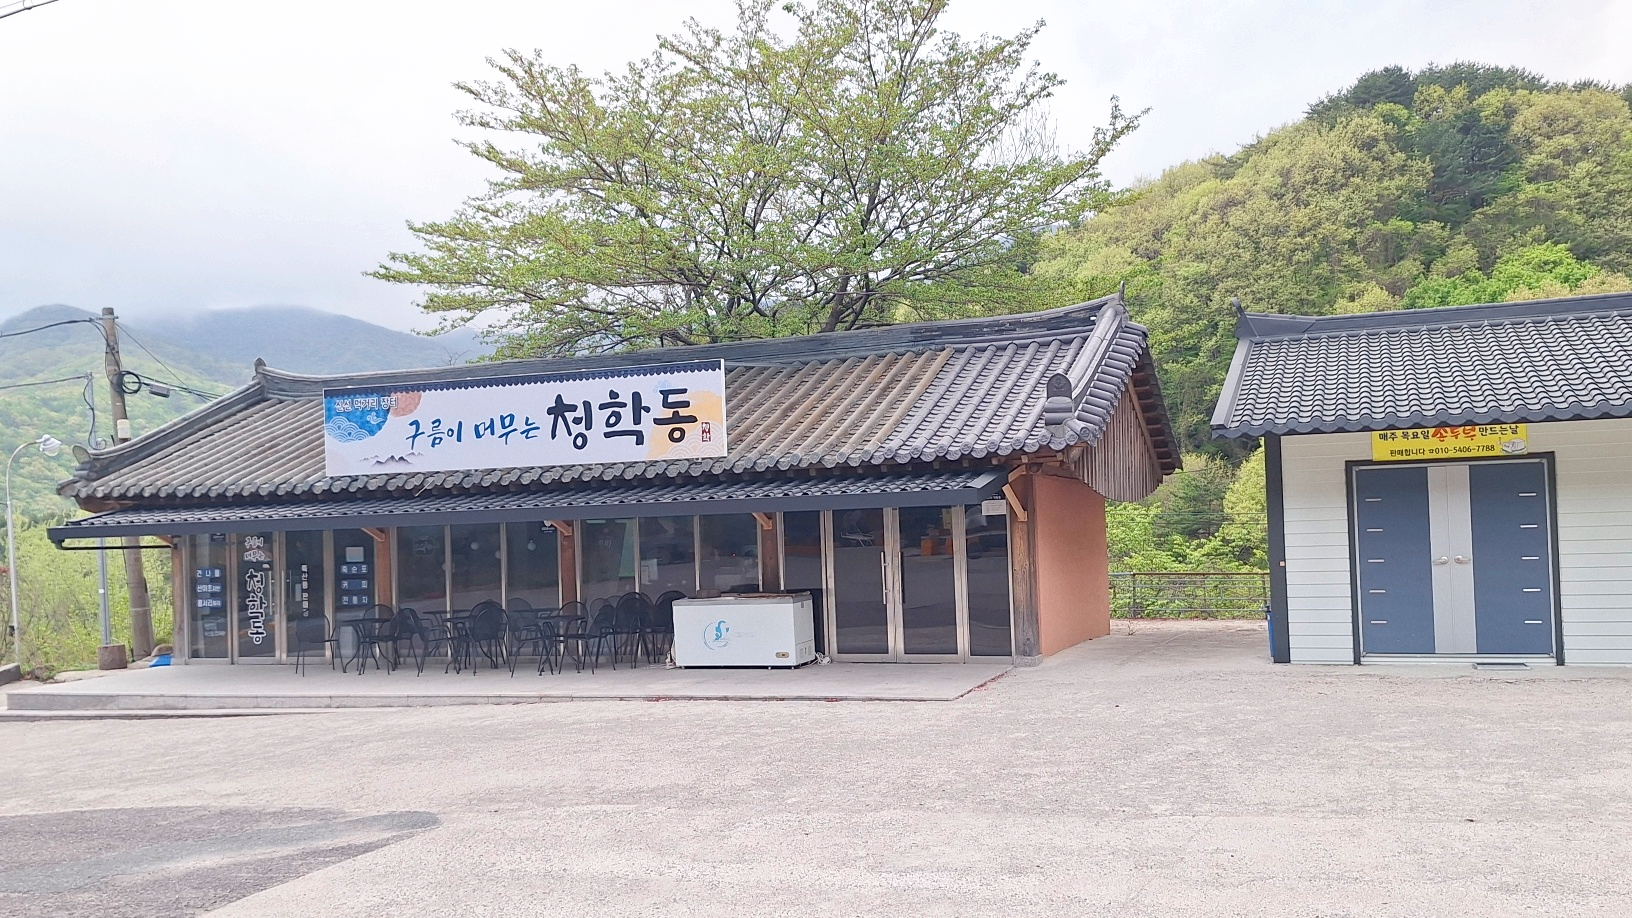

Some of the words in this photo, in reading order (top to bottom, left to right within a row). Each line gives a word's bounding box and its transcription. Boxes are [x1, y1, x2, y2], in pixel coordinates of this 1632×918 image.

[335, 399, 352, 412] 신선
[354, 397, 378, 411] 먹거리
[381, 395, 397, 409] 장터
[405, 420, 462, 450] 구름이
[474, 412, 540, 446] 머무는
[546, 387, 699, 450] 청학동
[1379, 433, 1398, 442] 매주
[1401, 430, 1430, 441] 목요일
[1389, 448, 1426, 458] 판매합니다
[1435, 444, 1495, 455] 010-5406-7788
[246, 568, 267, 644] 청학동
